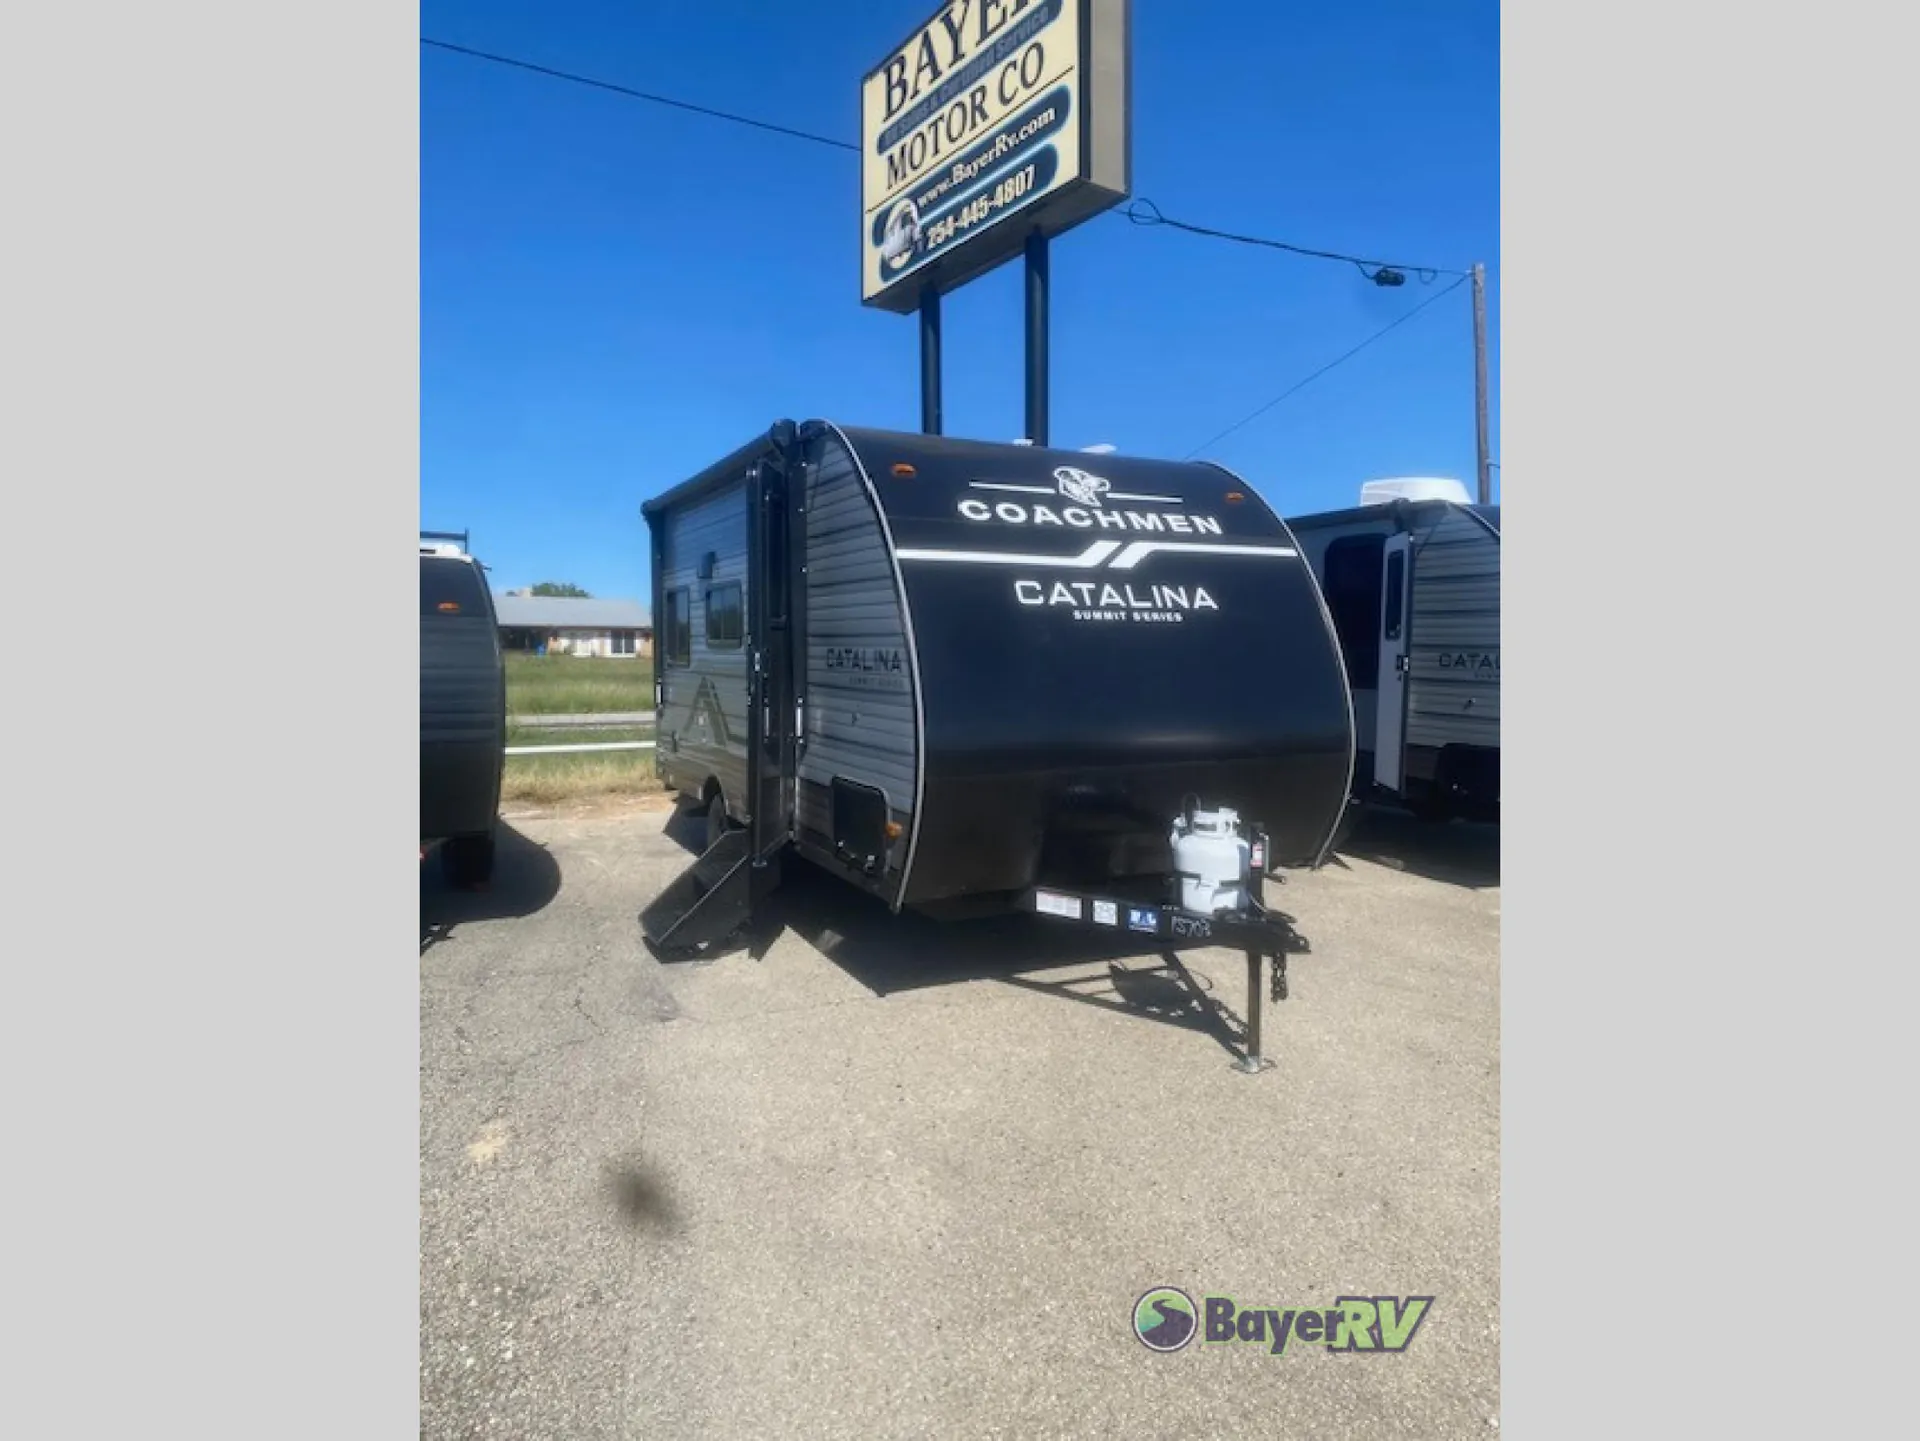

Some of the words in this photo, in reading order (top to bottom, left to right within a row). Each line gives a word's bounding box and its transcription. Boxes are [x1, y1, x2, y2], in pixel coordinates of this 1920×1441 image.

[882, 0, 1030, 122] BAYE
[886, 84, 990, 190] MOTOR
[997, 42, 1044, 106] CO
[917, 107, 1056, 207] www.BayerRv.com
[927, 164, 1036, 250] 254-445-4807
[957, 499, 1224, 535] COACHMEN
[1014, 580, 1219, 610] CATALINA
[1073, 609, 1127, 621] SUMMIT
[1132, 611, 1183, 623] SERIES
[826, 647, 902, 673] CATALINA
